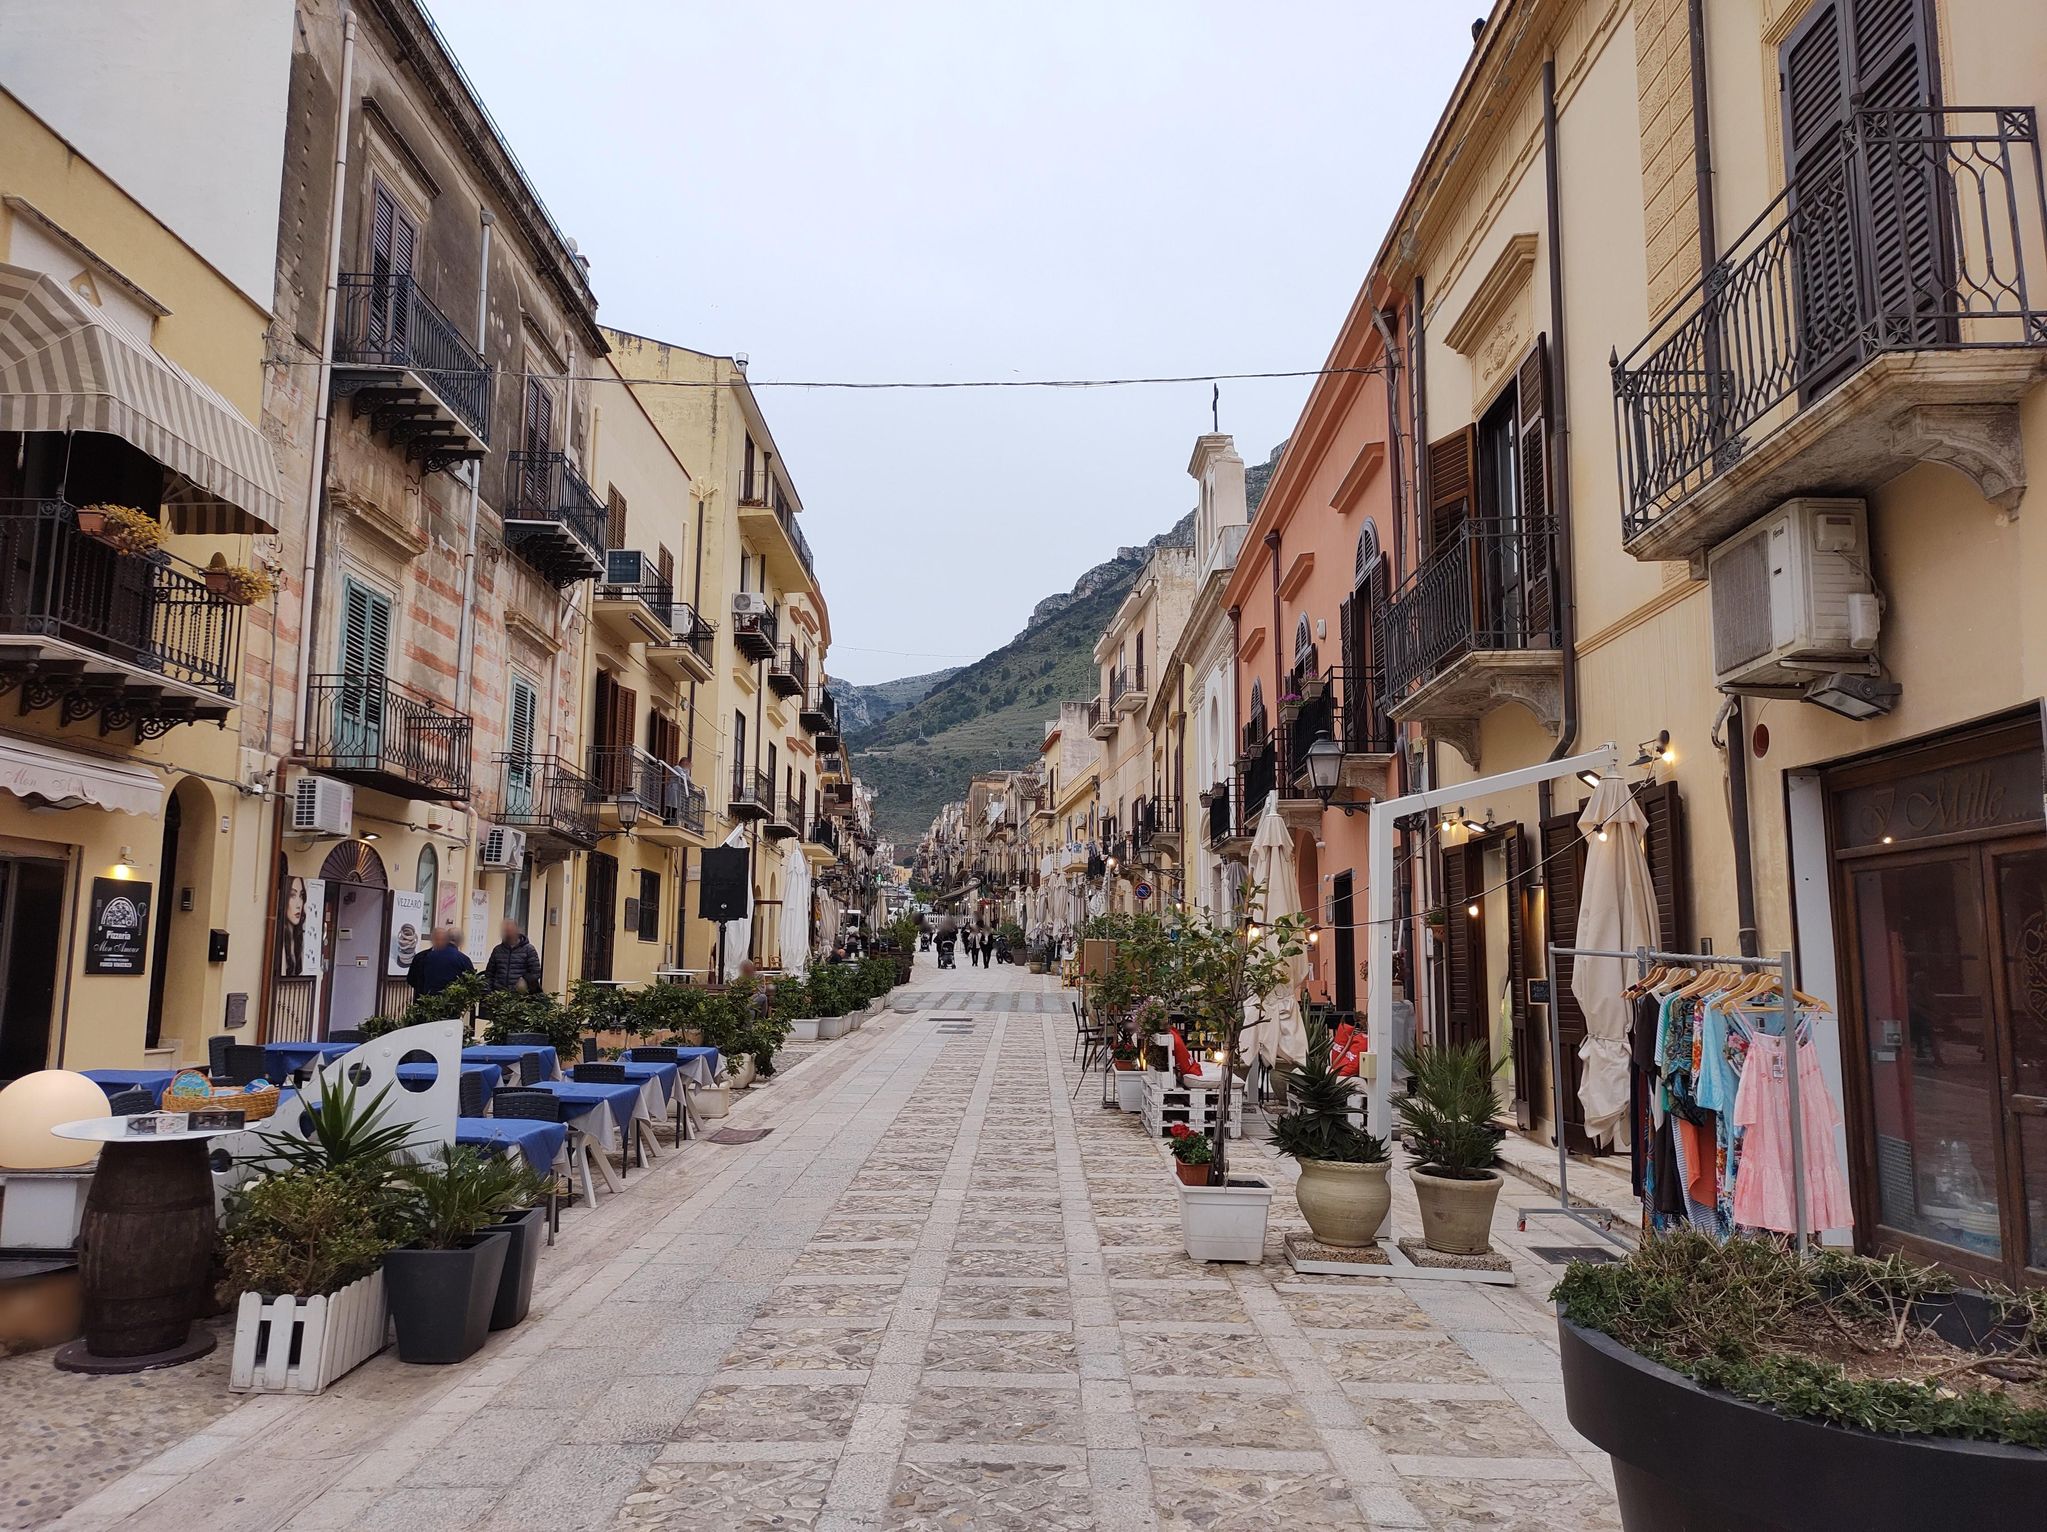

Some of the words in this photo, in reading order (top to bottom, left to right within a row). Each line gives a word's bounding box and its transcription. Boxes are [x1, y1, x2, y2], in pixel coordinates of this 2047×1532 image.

[106, 930, 131, 940] Pizzeria
[93, 940, 113, 952] Mon
[113, 941, 140, 953] Amour
